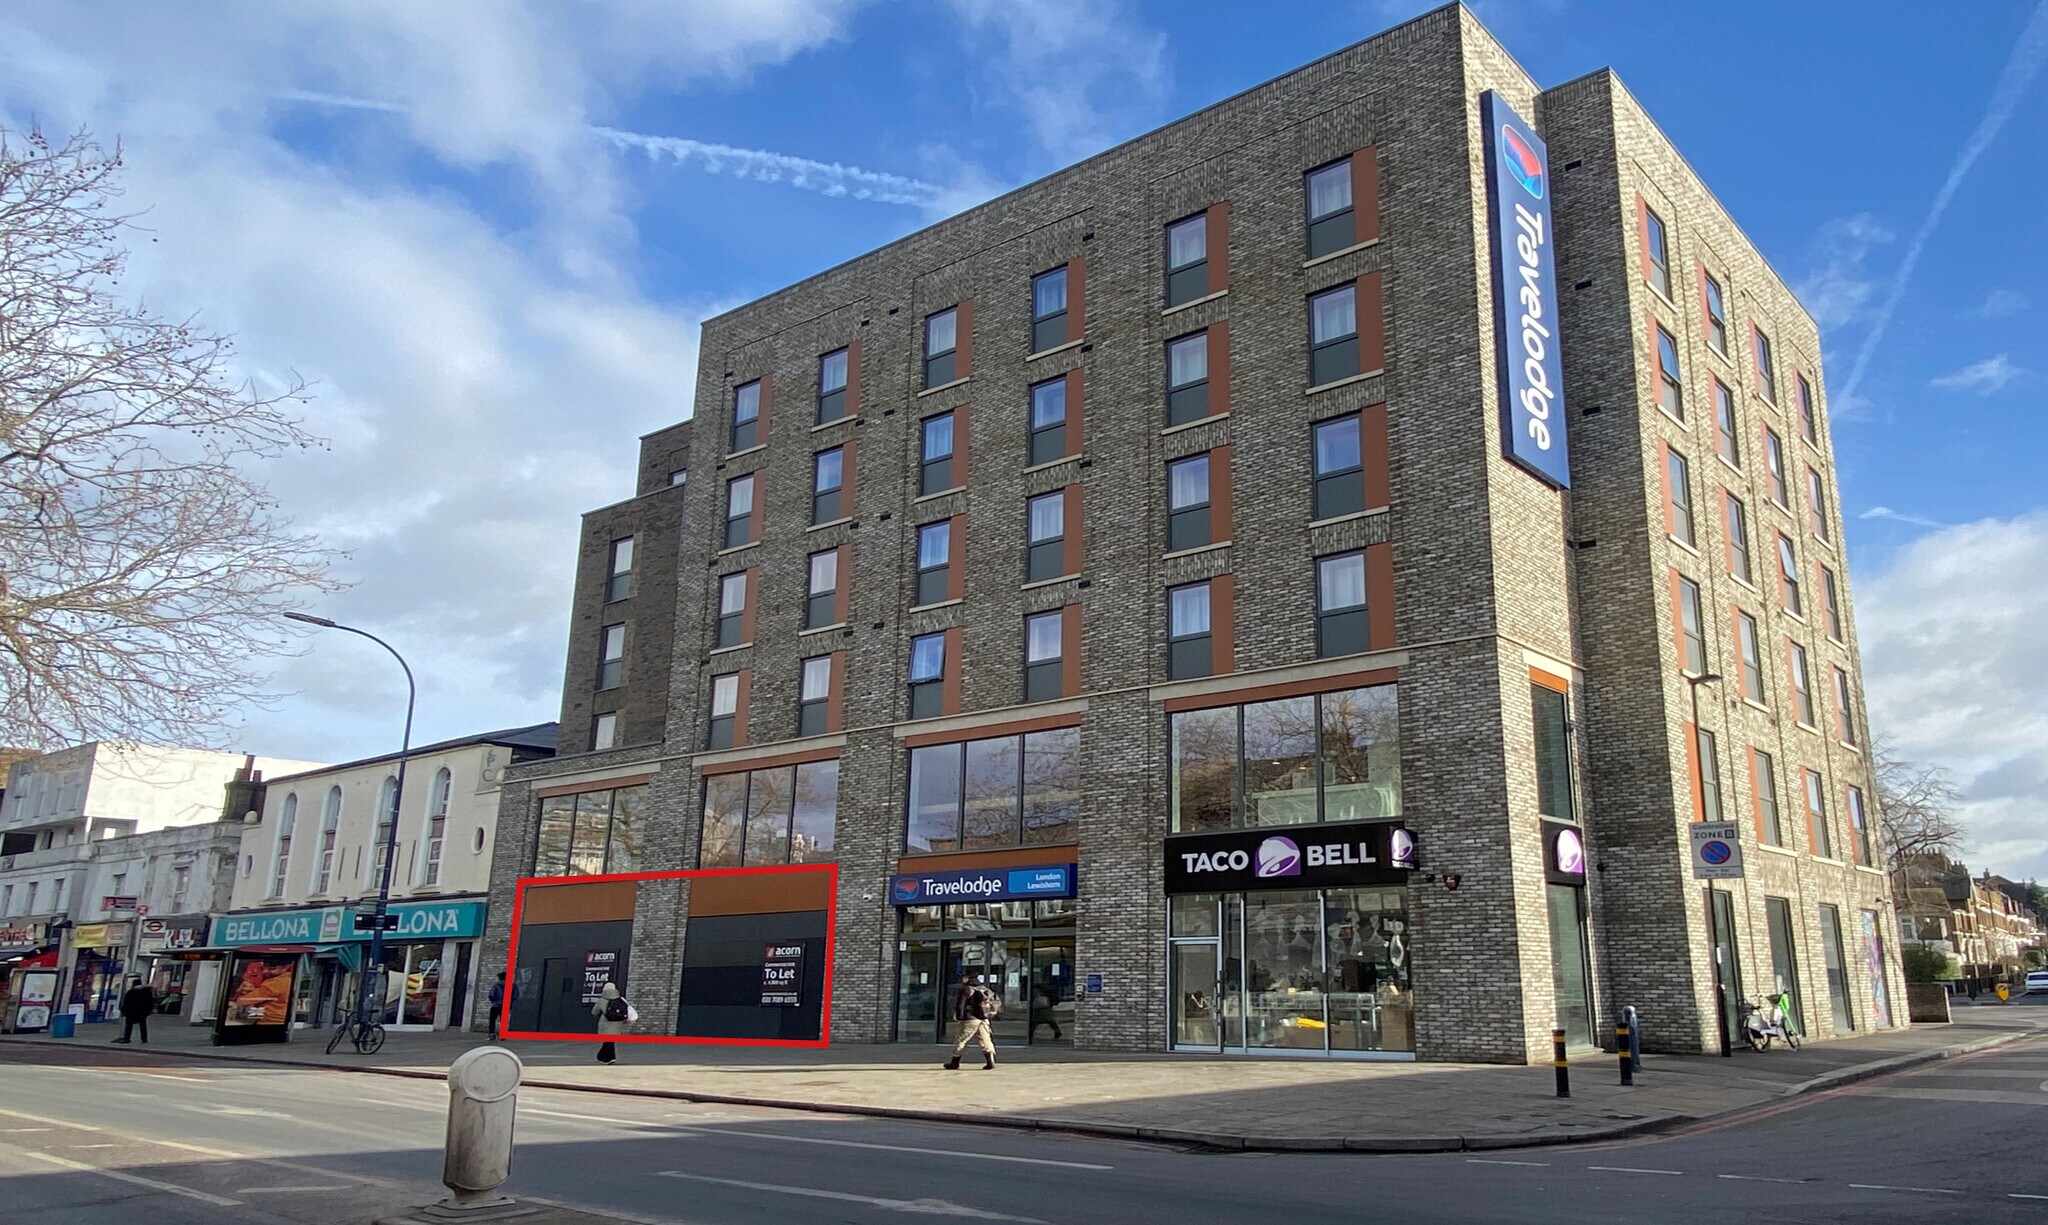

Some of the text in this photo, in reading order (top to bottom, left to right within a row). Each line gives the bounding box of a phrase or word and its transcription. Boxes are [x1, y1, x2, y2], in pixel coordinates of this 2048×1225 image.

[1514, 203, 1554, 451] Travelodge
[1694, 831, 1723, 839] ZONE
[1181, 842, 1376, 873] TACO BELL
[1035, 873, 1061, 881] London
[923, 875, 1002, 896] Travelodge
[1027, 881, 1061, 889] Lewisham
[353, 909, 459, 935] LONA
[225, 917, 311, 942] BELLONA
[775, 946, 801, 955] acorn
[594, 952, 615, 960] acorn
[585, 972, 609, 982] To Let
[764, 968, 795, 979] To Let
